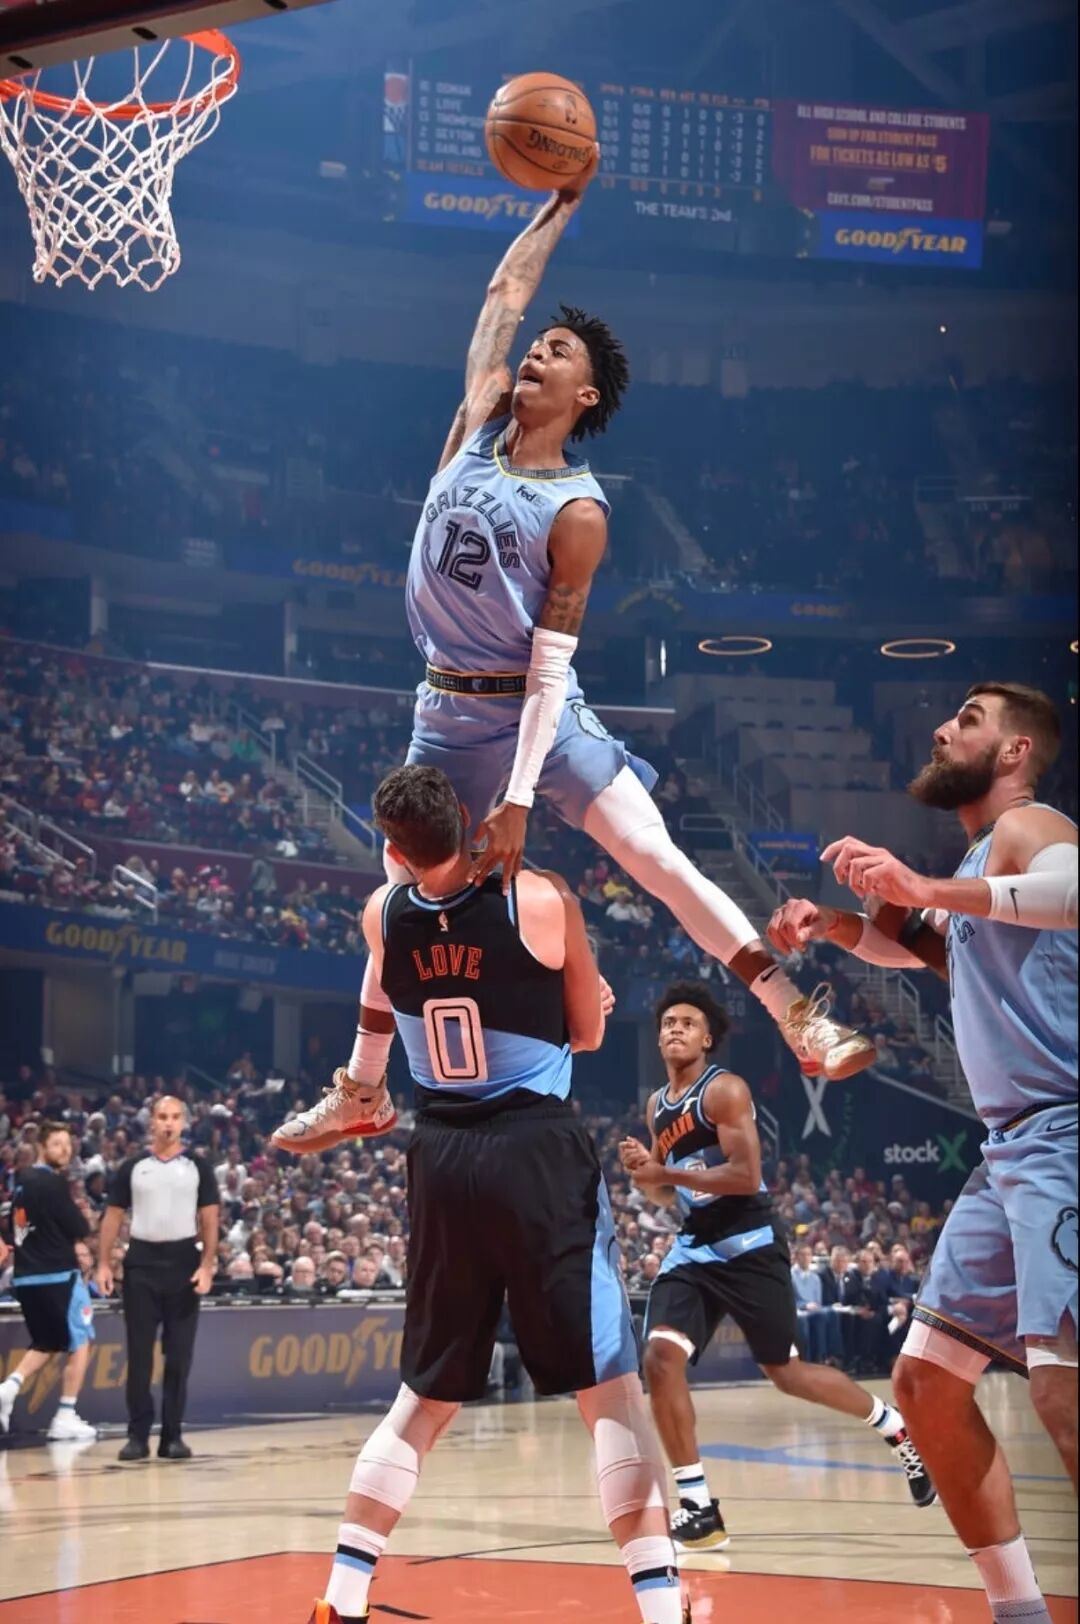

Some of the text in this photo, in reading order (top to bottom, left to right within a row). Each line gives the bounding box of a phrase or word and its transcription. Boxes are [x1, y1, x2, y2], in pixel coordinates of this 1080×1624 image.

[833, 145, 874, 164] TICKETS
[634, 200, 659, 216] THE
[834, 227, 968, 254] GOODYEAR
[425, 486, 520, 569] GRIZZLIES
[437, 519, 492, 592] 12
[46, 921, 188, 964] GOODYEAR
[413, 944, 482, 981] LOVE
[422, 997, 489, 1084] 0
